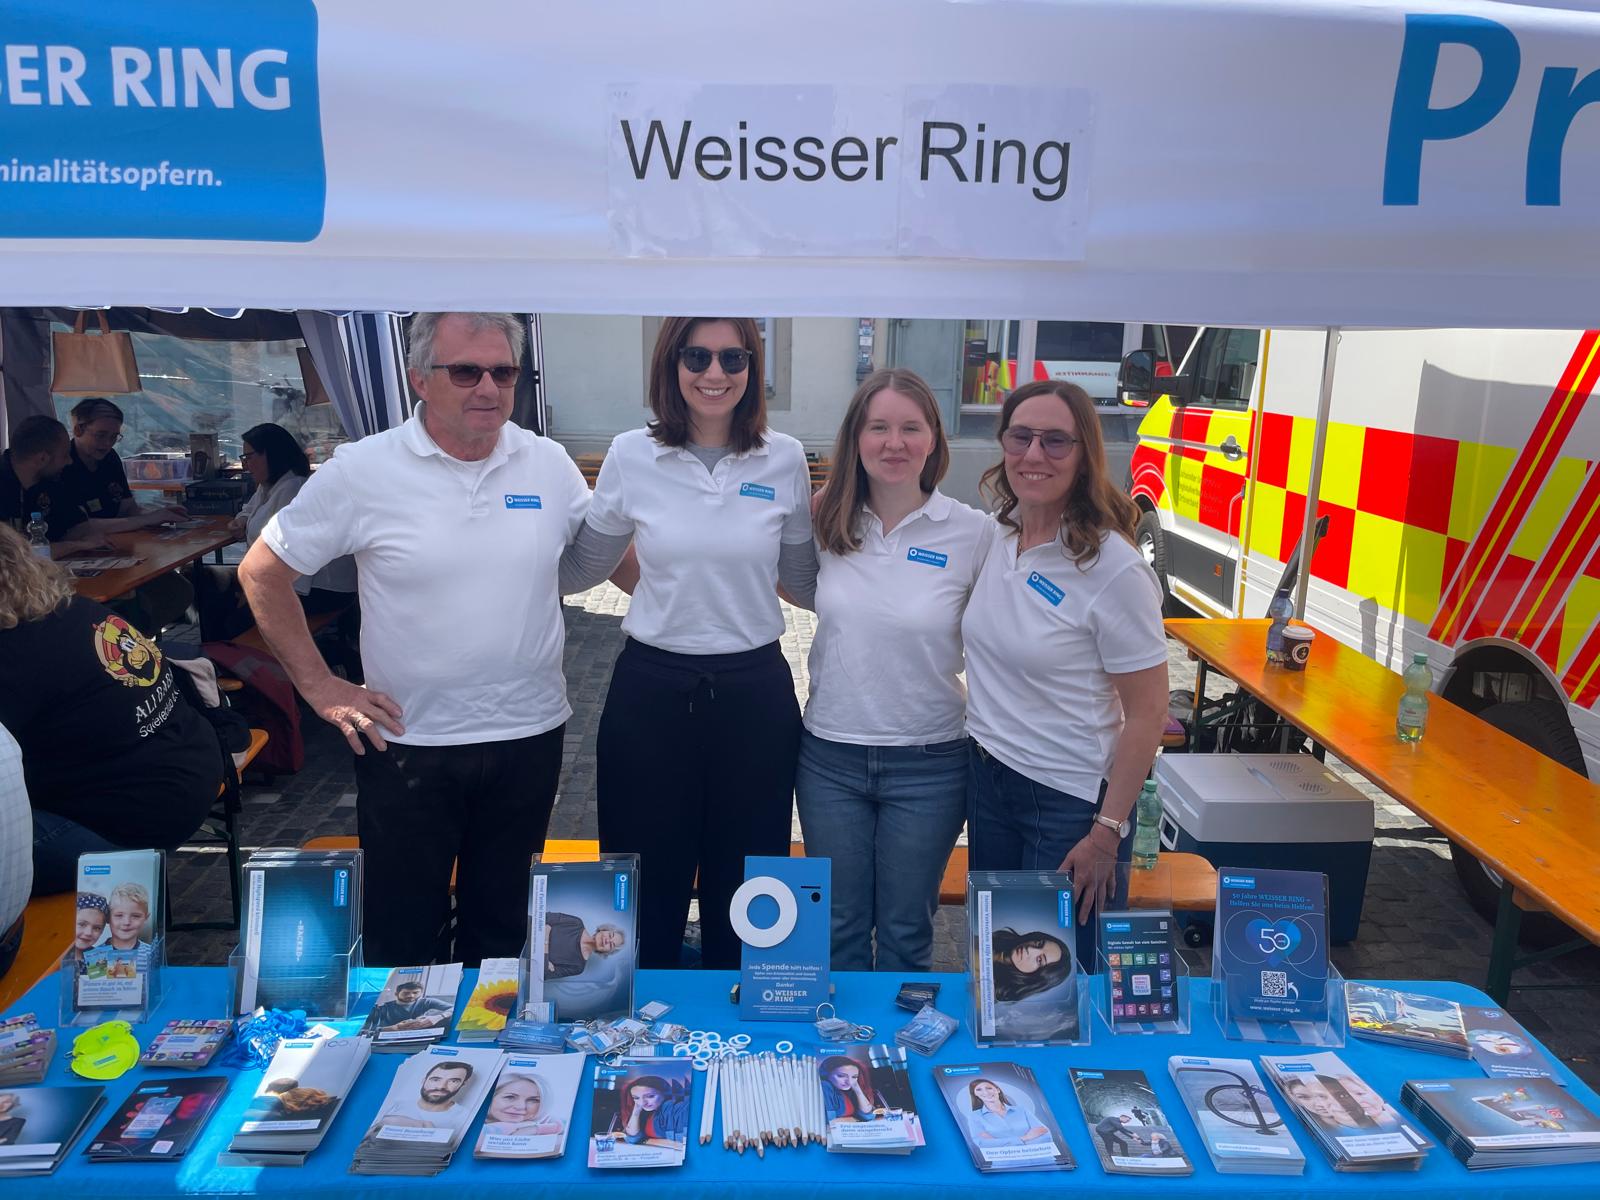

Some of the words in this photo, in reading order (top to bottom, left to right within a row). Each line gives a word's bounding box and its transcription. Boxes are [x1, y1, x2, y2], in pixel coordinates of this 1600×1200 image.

[0, 44, 92, 107] ER
[110, 45, 292, 111] RING
[620, 119, 899, 182] Weisser
[919, 120, 1071, 202] Ring
[1258, 928, 1291, 954] 50
[761, 963, 789, 971] Spende
